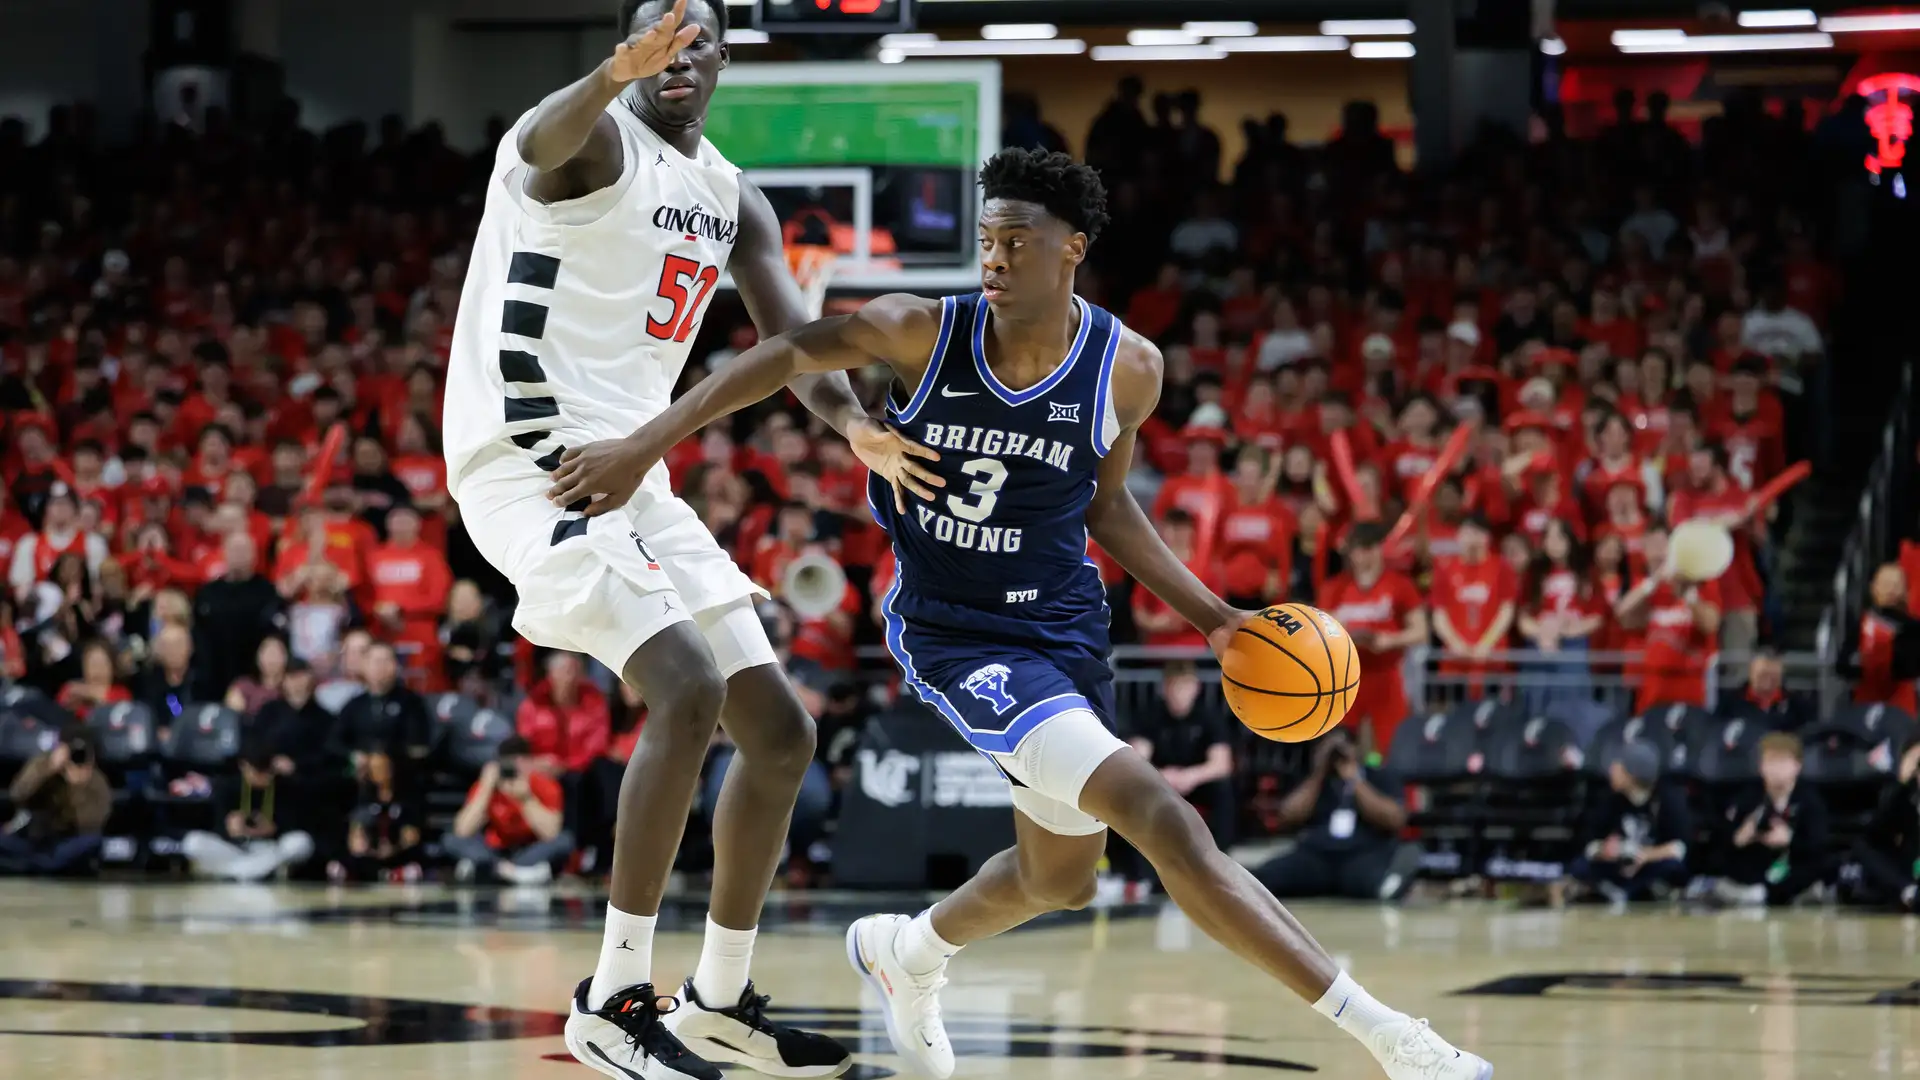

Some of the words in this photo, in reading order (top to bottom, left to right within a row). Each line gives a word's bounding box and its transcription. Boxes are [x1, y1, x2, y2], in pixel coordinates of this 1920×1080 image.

[652, 204, 739, 244] CINCINNA
[645, 253, 719, 343] 52
[924, 423, 1074, 472] BRIGHAM
[947, 457, 1008, 522] 3
[917, 504, 1022, 552] YOUNG
[1006, 589, 1038, 603] BYU
